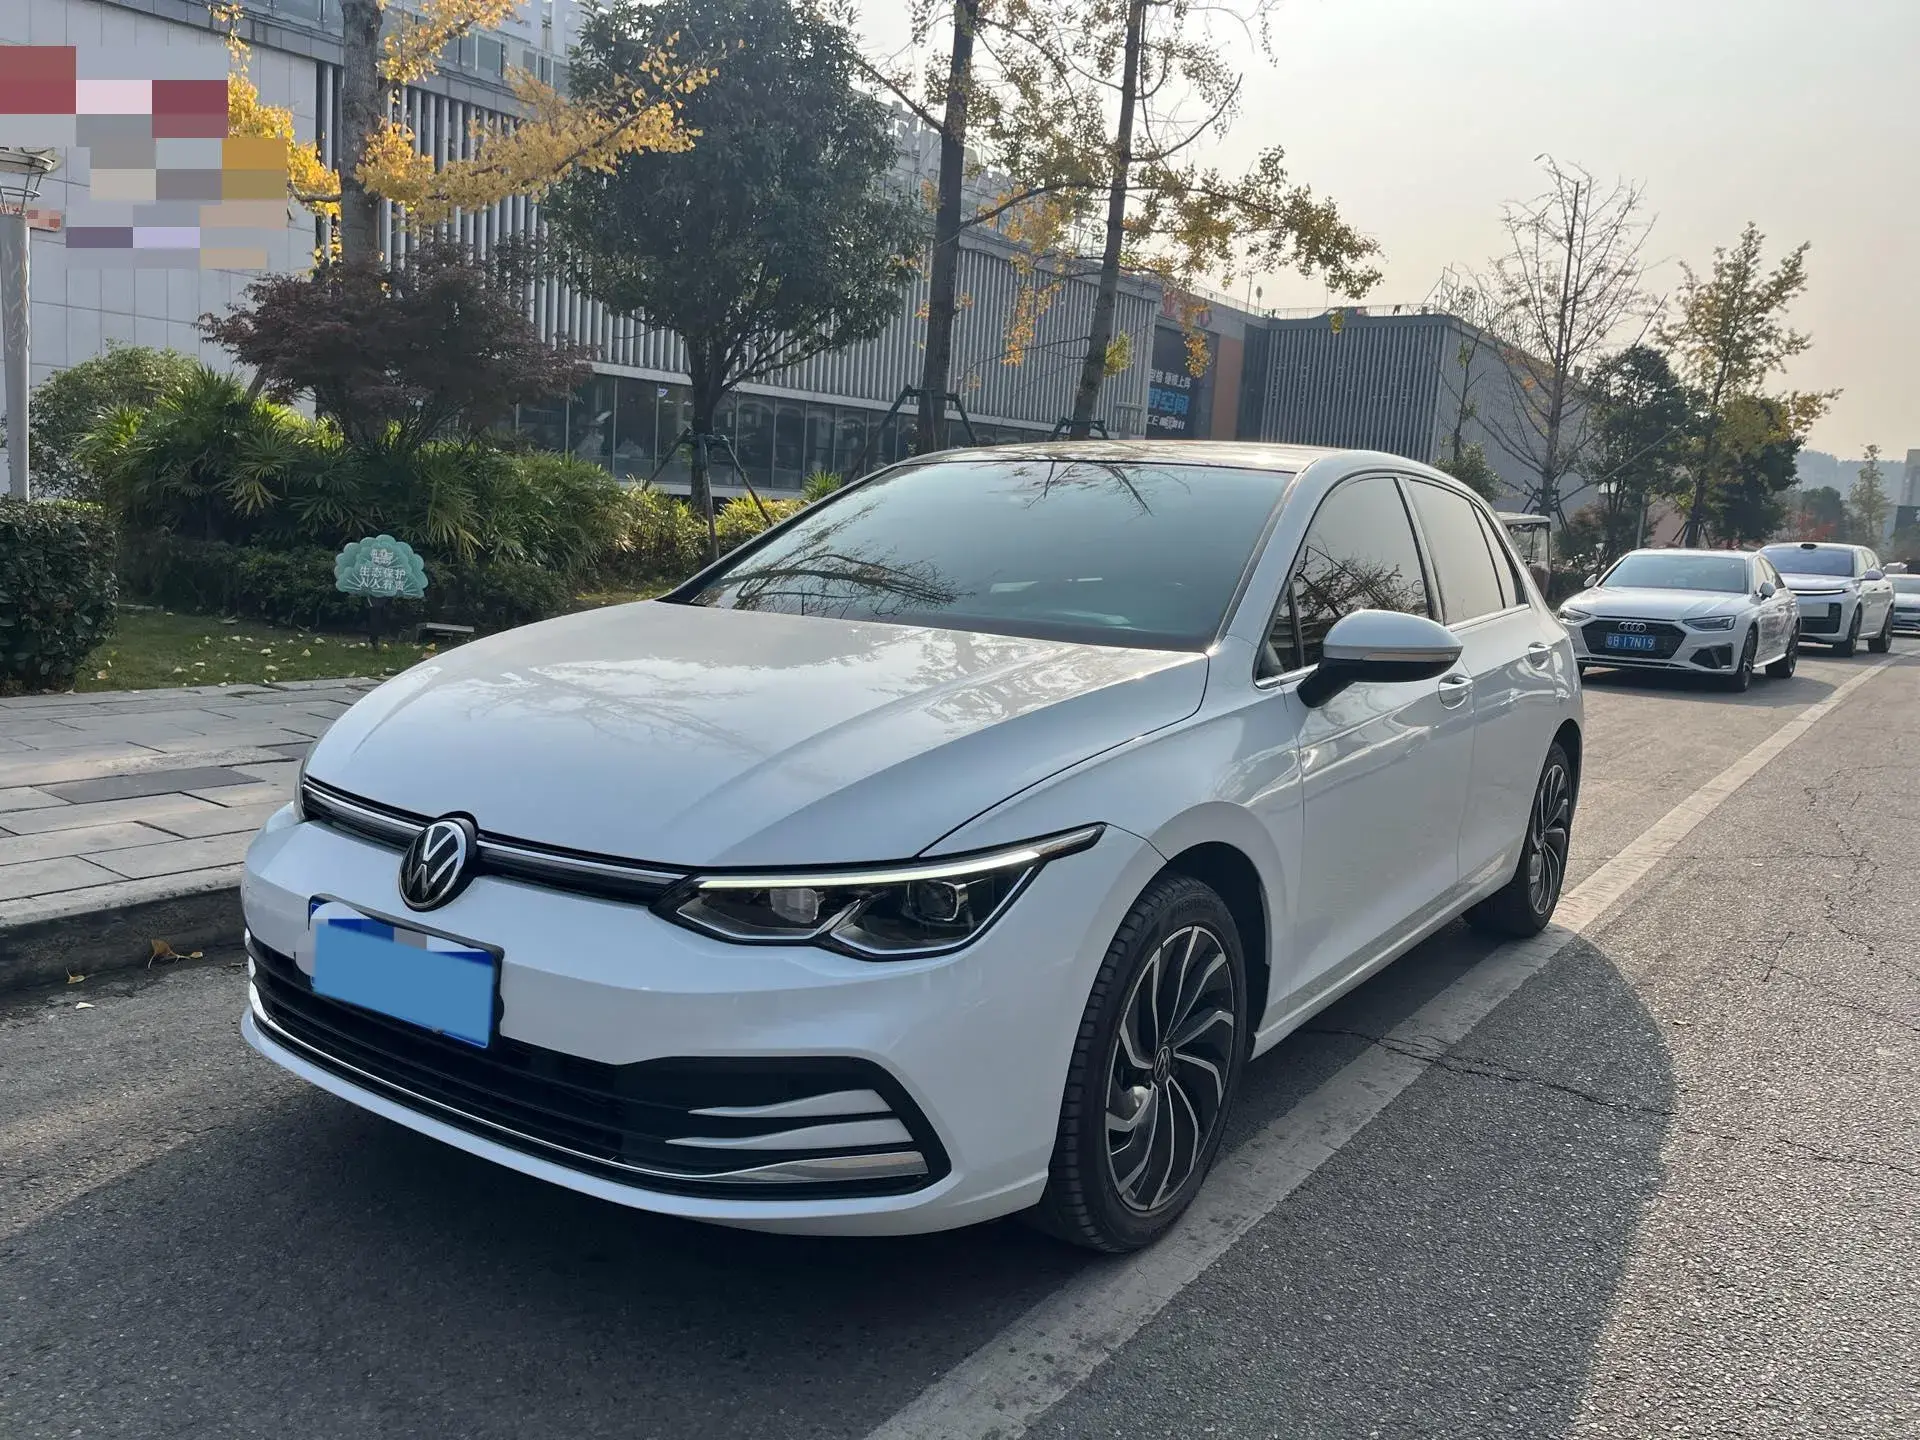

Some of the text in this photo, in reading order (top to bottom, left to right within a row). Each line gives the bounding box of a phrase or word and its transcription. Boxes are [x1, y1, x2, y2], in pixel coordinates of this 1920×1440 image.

[360, 565, 406, 580] 生态保护
[360, 577, 404, 591] 人人有责
